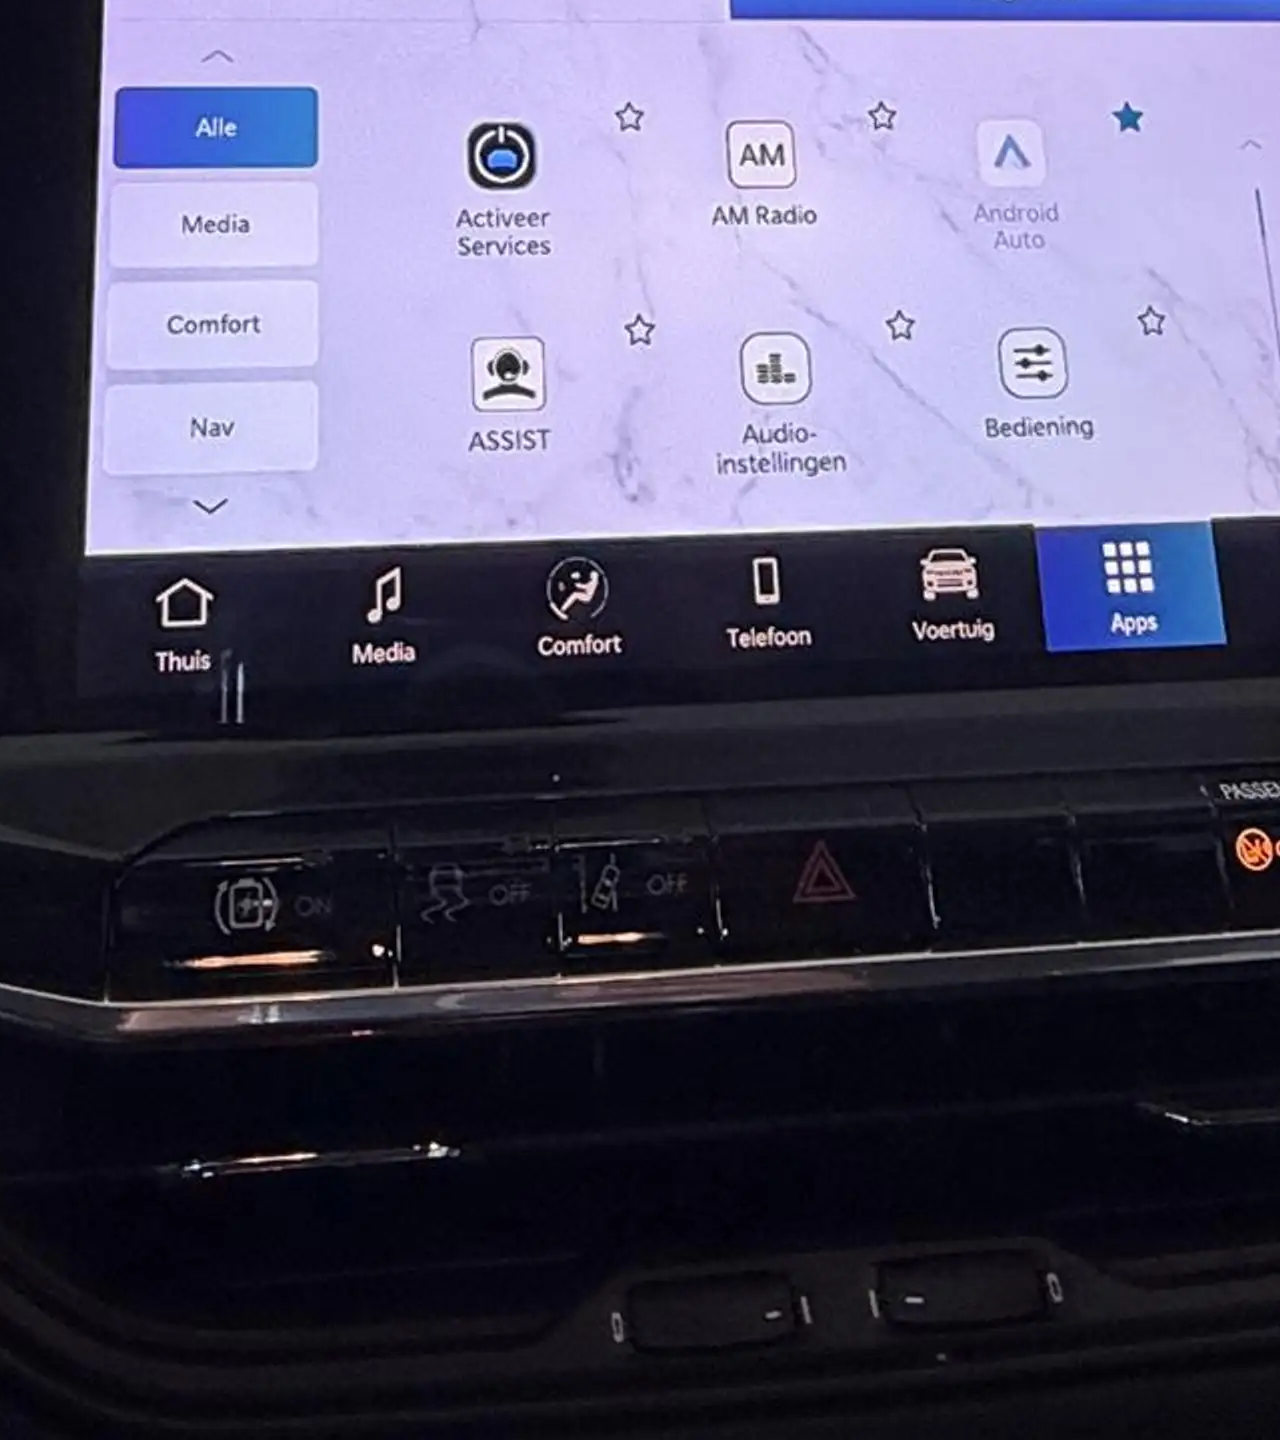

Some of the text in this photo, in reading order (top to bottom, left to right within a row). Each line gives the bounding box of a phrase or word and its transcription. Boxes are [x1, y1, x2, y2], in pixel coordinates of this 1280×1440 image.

[194, 117, 239, 139] Alle
[739, 143, 786, 167] AM
[181, 214, 252, 236] Media
[455, 207, 551, 229] Activeer
[711, 204, 818, 227] AM Radio
[973, 203, 1059, 225] Android
[457, 236, 552, 257] Services
[993, 230, 1046, 251] Auto
[167, 313, 262, 336] Comfort
[189, 416, 236, 439] Nav
[741, 422, 818, 445] Audio-
[984, 415, 1095, 441] Bediening
[467, 429, 552, 452] ASSIST
[715, 451, 848, 477] instellingen
[911, 618, 995, 644] Voertuig
[1110, 611, 1159, 636] Apps
[537, 634, 623, 657] Comfort
[726, 625, 813, 648] Telefoon
[155, 650, 212, 673] Thuis
[351, 641, 417, 665] Media
[489, 882, 532, 907] OFF
[646, 872, 688, 896] OFF
[293, 894, 334, 917] ON
